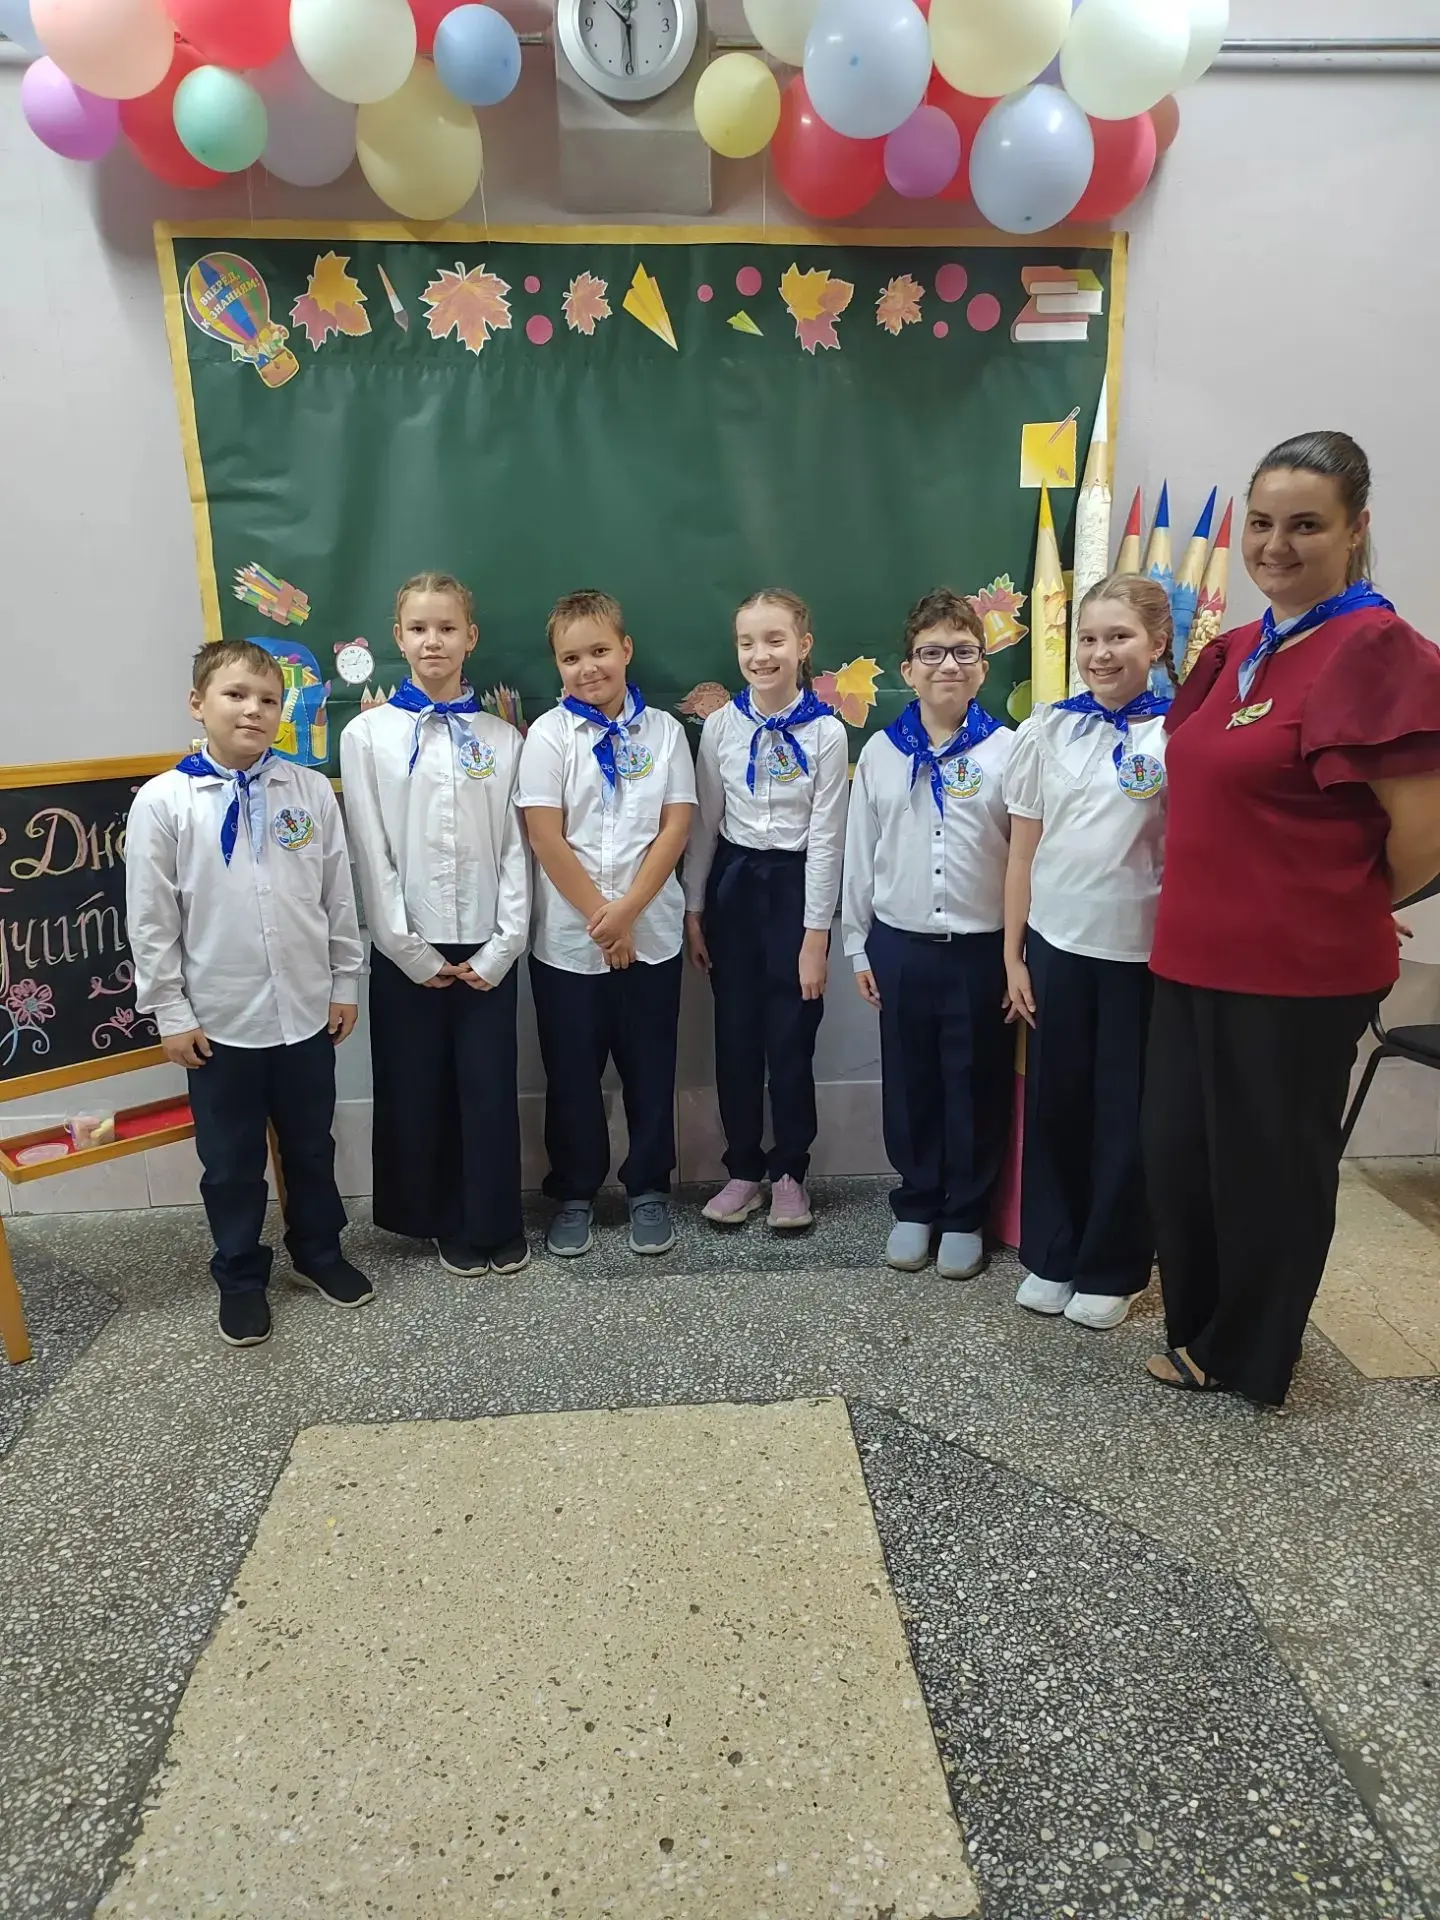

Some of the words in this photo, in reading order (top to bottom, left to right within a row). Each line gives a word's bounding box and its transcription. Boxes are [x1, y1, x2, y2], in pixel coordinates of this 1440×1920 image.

[584, 17, 594, 32] 9
[661, 17, 670, 33] 3
[625, 61, 634, 75] 6
[200, 318, 211, 330] К
[209, 277, 260, 319] ЗНАНИЯМ!
